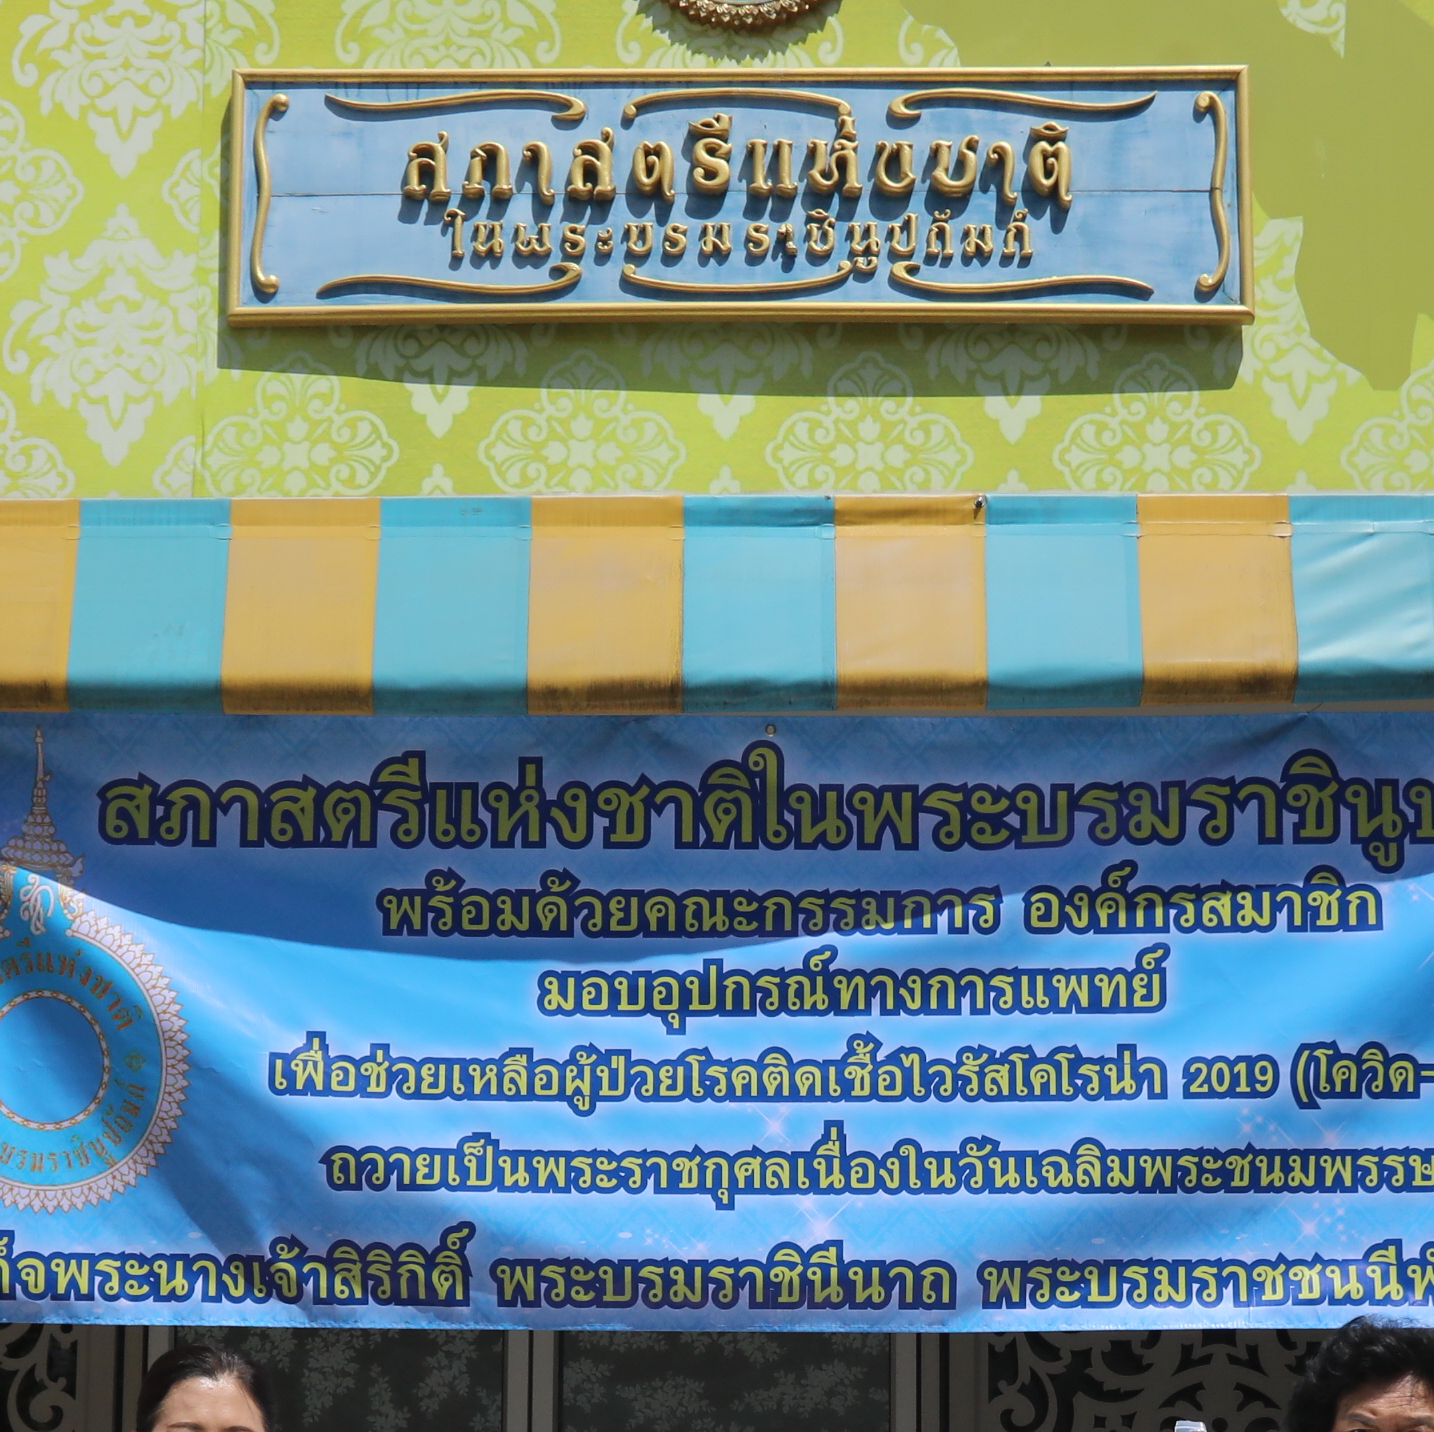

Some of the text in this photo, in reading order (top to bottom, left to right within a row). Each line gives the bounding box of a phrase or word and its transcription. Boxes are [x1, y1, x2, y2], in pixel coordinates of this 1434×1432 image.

[383, 861, 1383, 937] พร้อมด้วยคณะกรรมการ องค์กรสมาชิก
[540, 945, 1169, 1031] มอบอุปกรณ์ทางการแพทย์
[270, 1034, 1164, 1113] เพื่อช่วยเหลือผู้ป่วยโรคติดเชื้อไวรัสโคโรน่า
[1183, 1055, 1276, 1096] 2019
[495, 1241, 955, 1309] พระบรมราชินีนาถ
